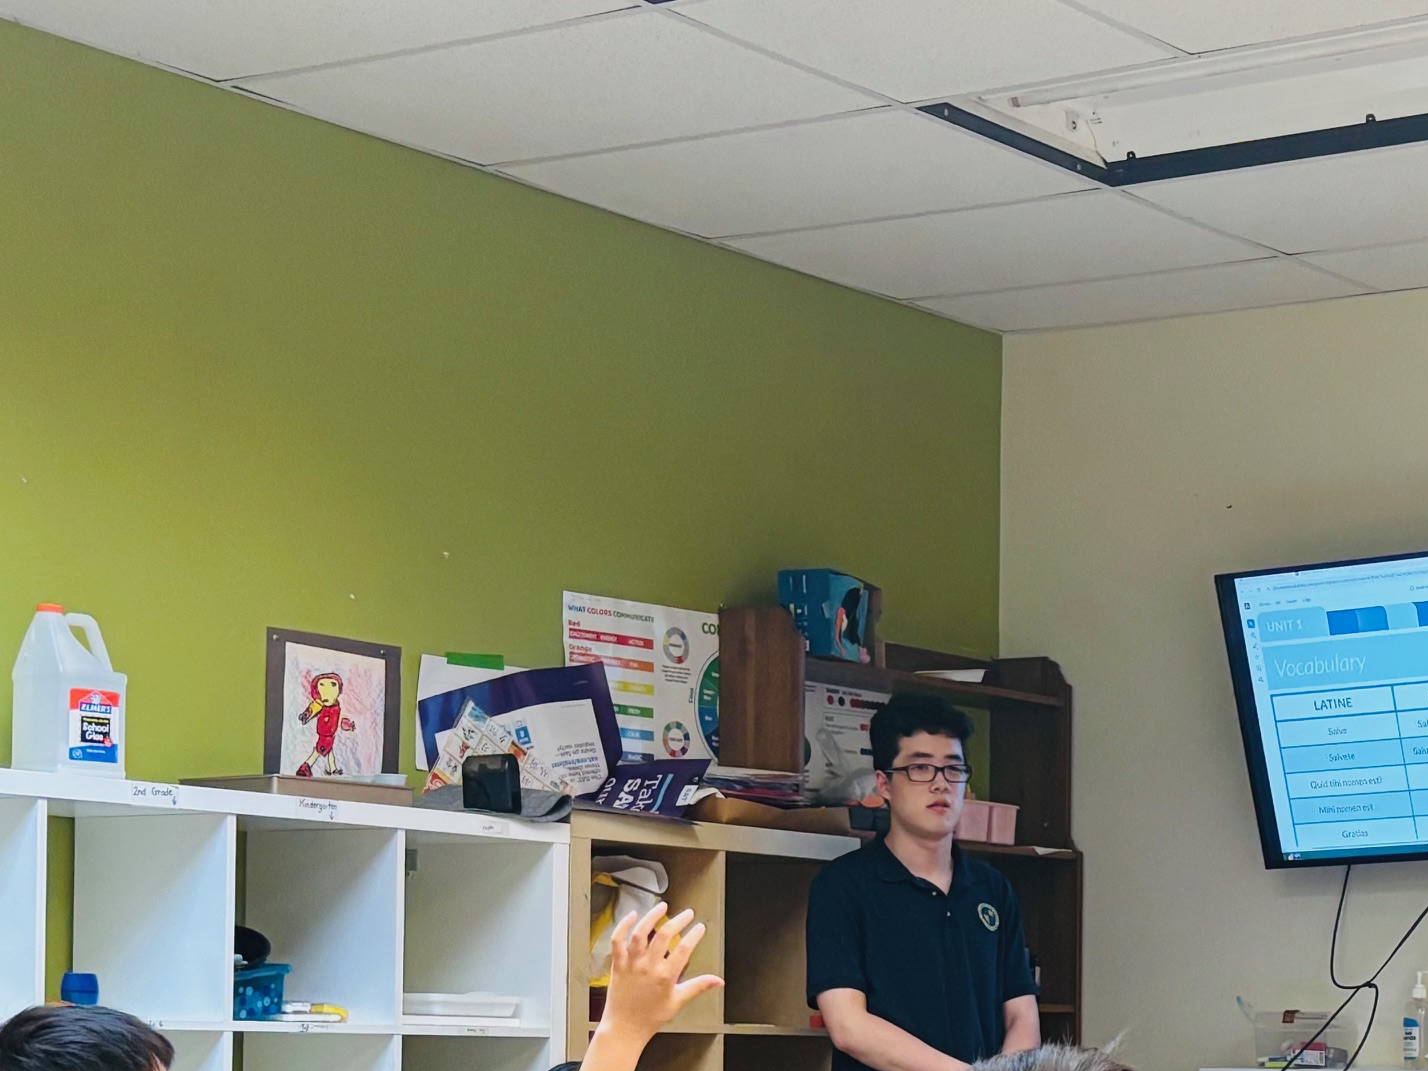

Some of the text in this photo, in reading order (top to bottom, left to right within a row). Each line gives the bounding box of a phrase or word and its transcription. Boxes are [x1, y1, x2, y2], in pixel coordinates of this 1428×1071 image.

[568, 605, 586, 613] WHAT
[587, 607, 612, 616] COLORS
[1266, 618, 1303, 633] UNIT 1
[1274, 654, 1366, 677] Vocabulary
[81, 704, 111, 714] ELMER'S
[1314, 698, 1352, 711] LATINE
[83, 722, 109, 733] School
[133, 786, 173, 797] 2nd Grade
[630, 774, 663, 812] Tak
[299, 799, 338, 813] Kindergarten
